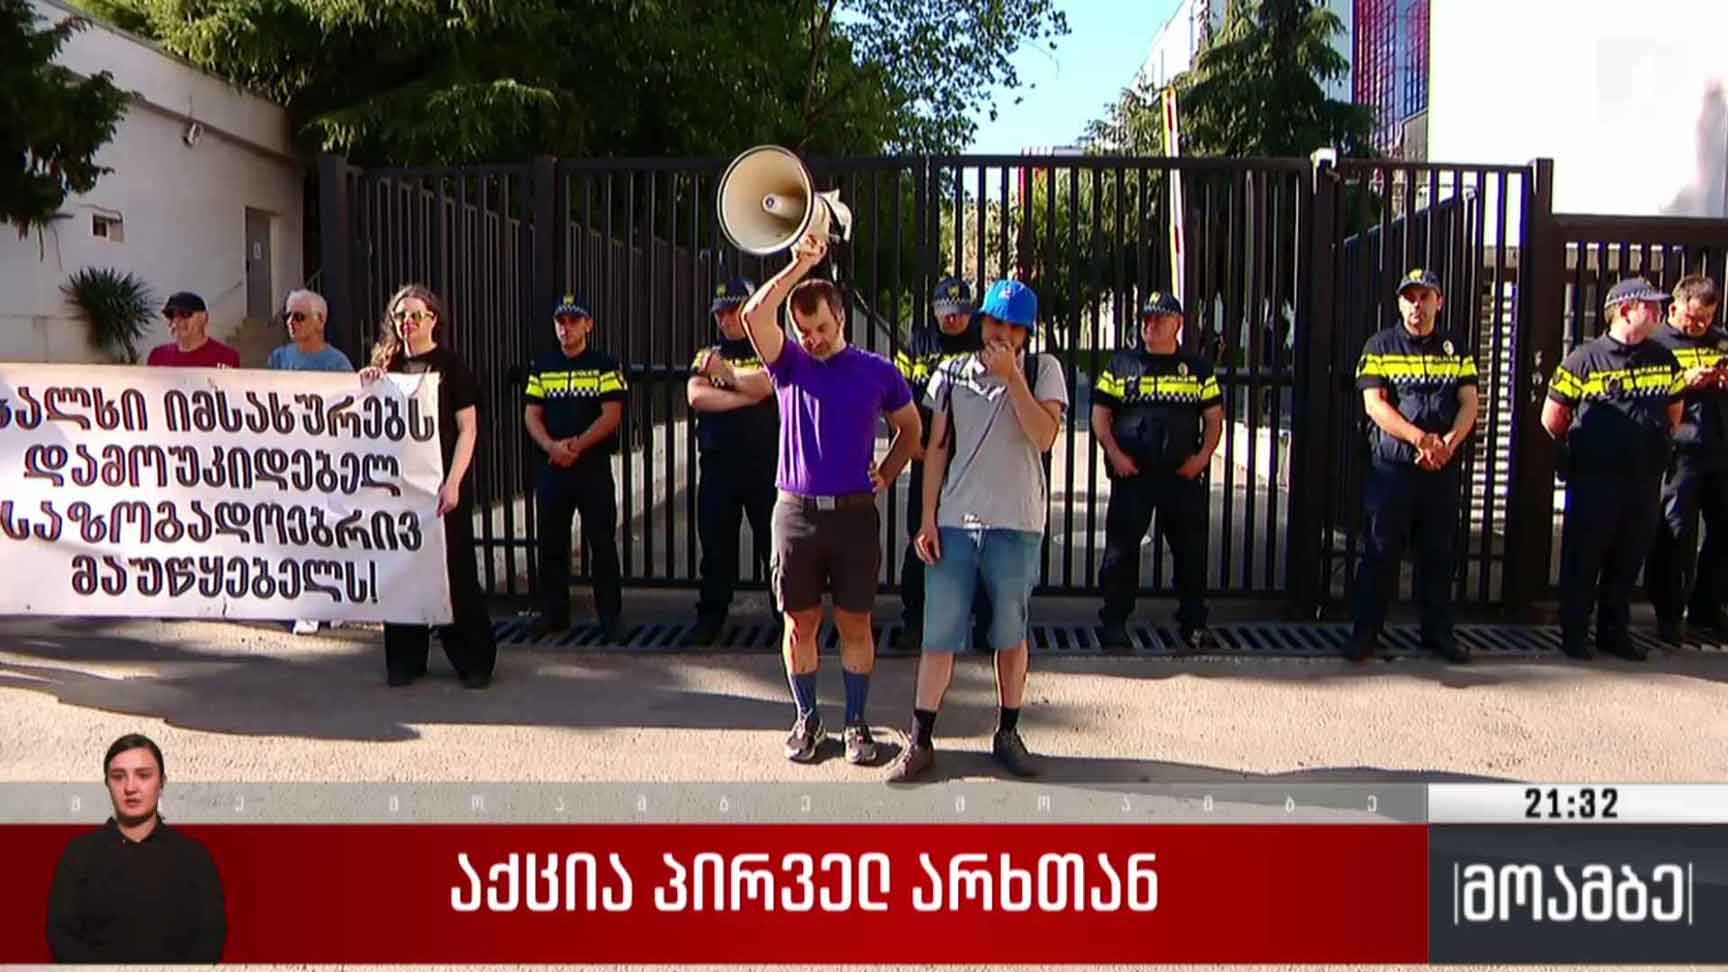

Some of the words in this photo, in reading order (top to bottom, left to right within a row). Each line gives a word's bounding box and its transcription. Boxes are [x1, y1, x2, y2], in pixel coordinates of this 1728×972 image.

[164, 388, 435, 442] იმსახურებს
[23, 443, 401, 497] დამოუკიდებელ
[0, 500, 422, 552] საზოგადოებრივ
[72, 554, 378, 604] მაუწყებელს!
